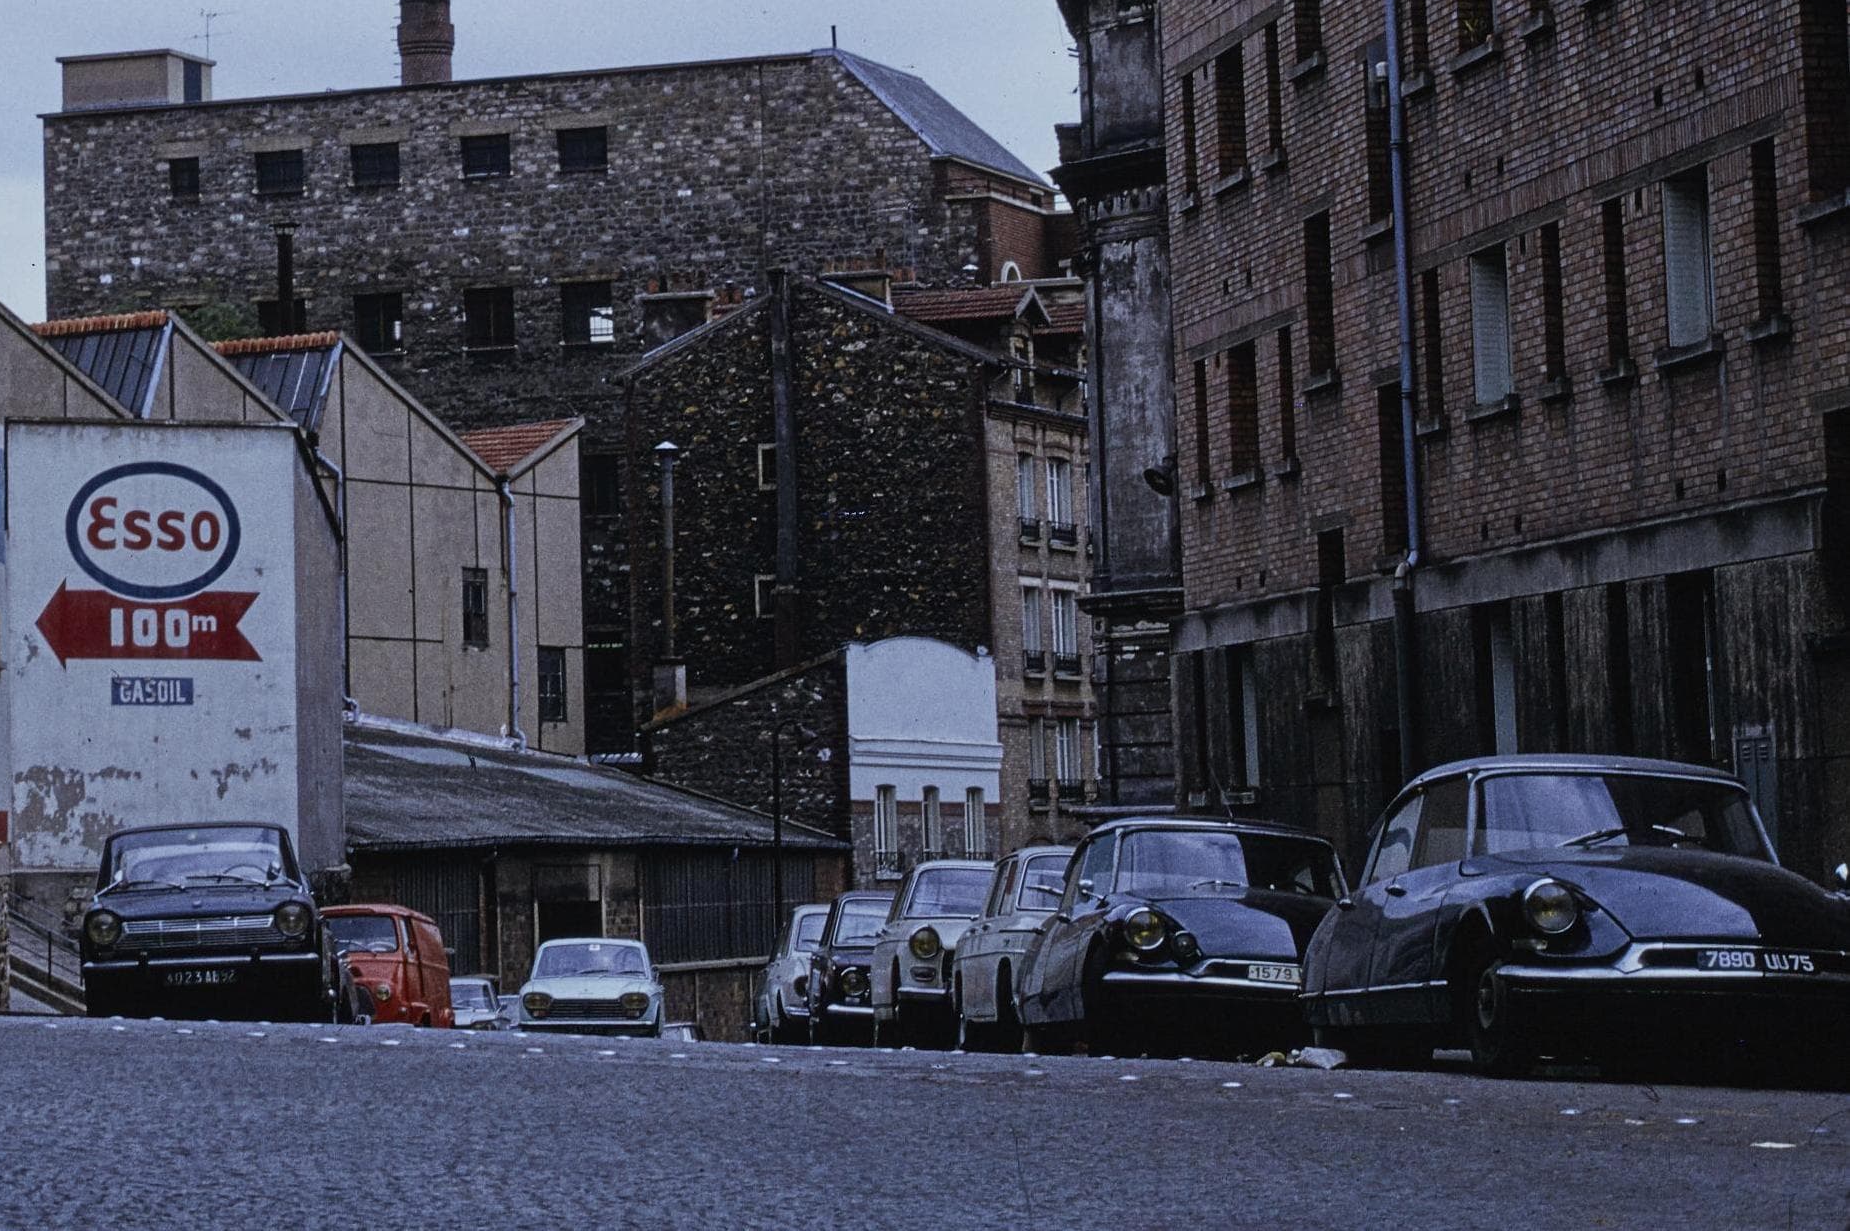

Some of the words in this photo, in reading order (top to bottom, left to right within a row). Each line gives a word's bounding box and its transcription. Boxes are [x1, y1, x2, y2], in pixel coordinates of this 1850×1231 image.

[86, 496, 221, 552] Esso
[118, 678, 187, 704] GASOIL
[1705, 950, 1756, 969] 7890
